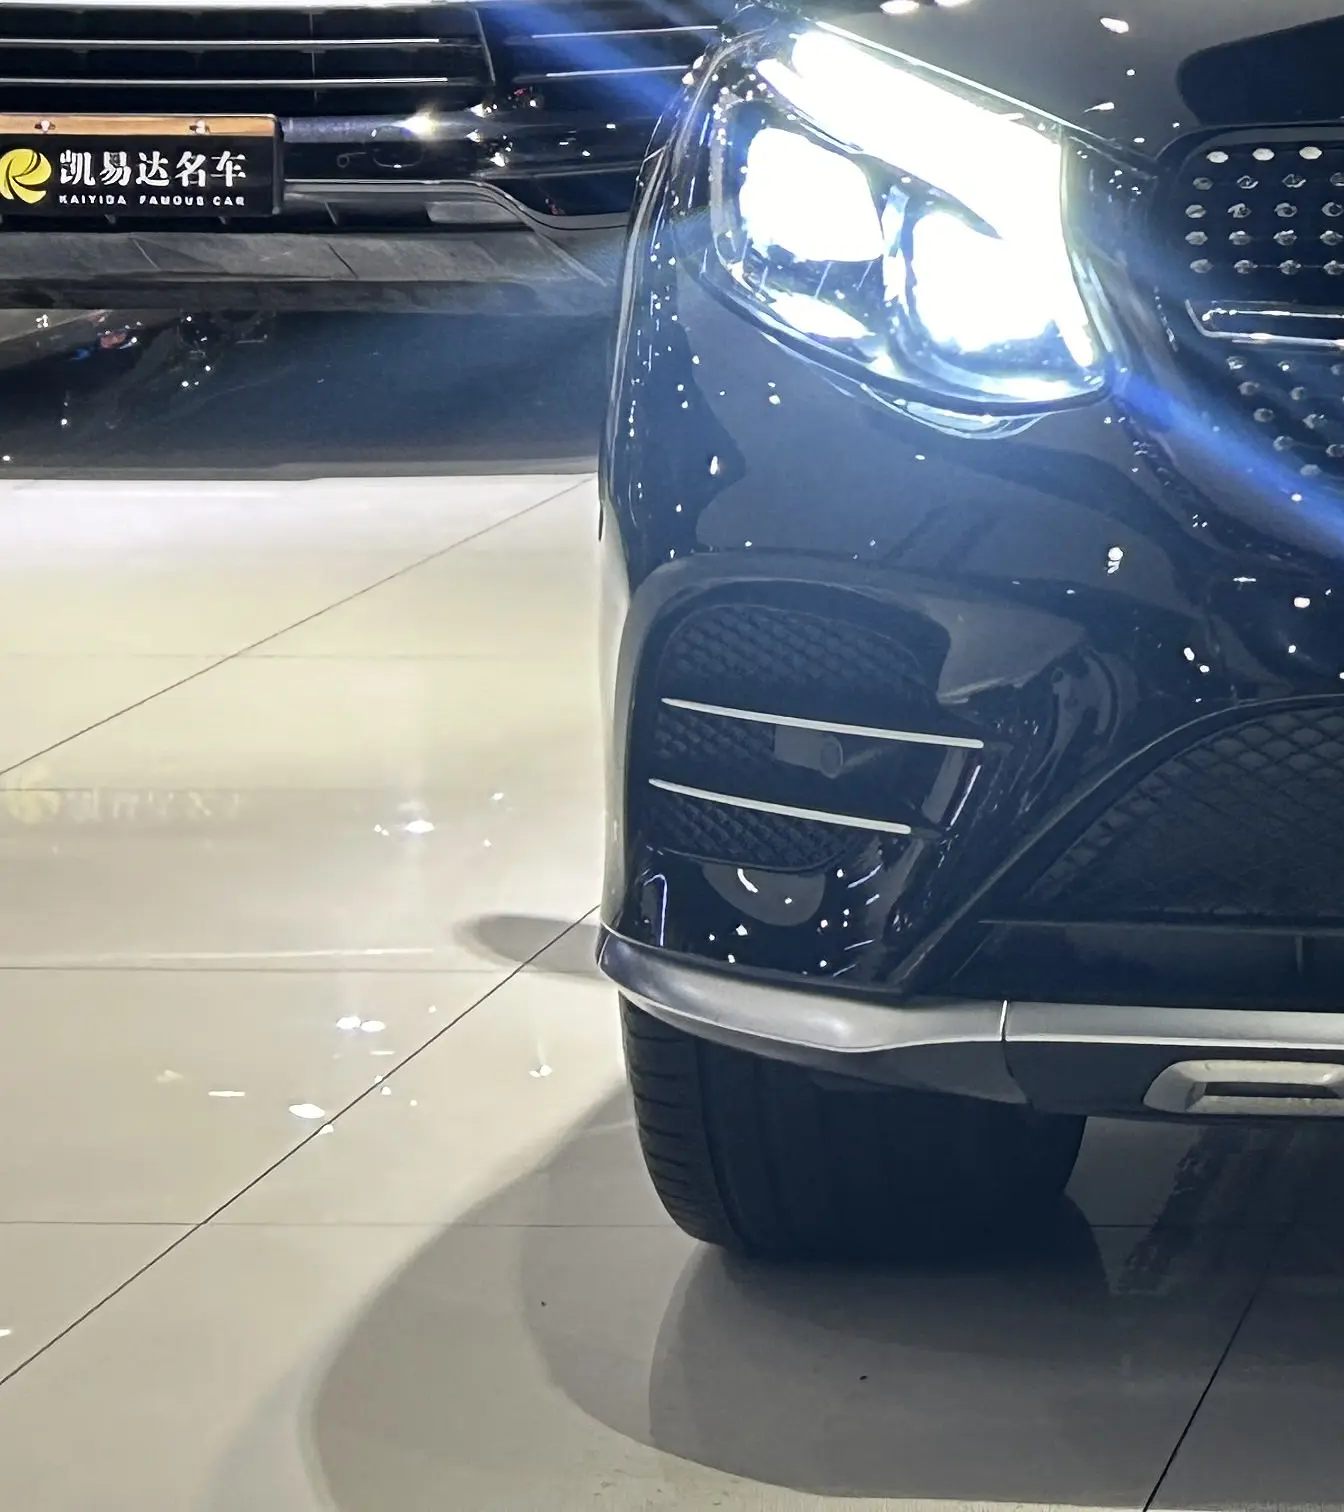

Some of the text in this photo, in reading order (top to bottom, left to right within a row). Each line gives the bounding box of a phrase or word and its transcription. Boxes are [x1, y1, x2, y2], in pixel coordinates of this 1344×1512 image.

[60, 150, 246, 187] 凯易达名车
[59, 195, 244, 206] KAIYIDA FAMOUS CAR
